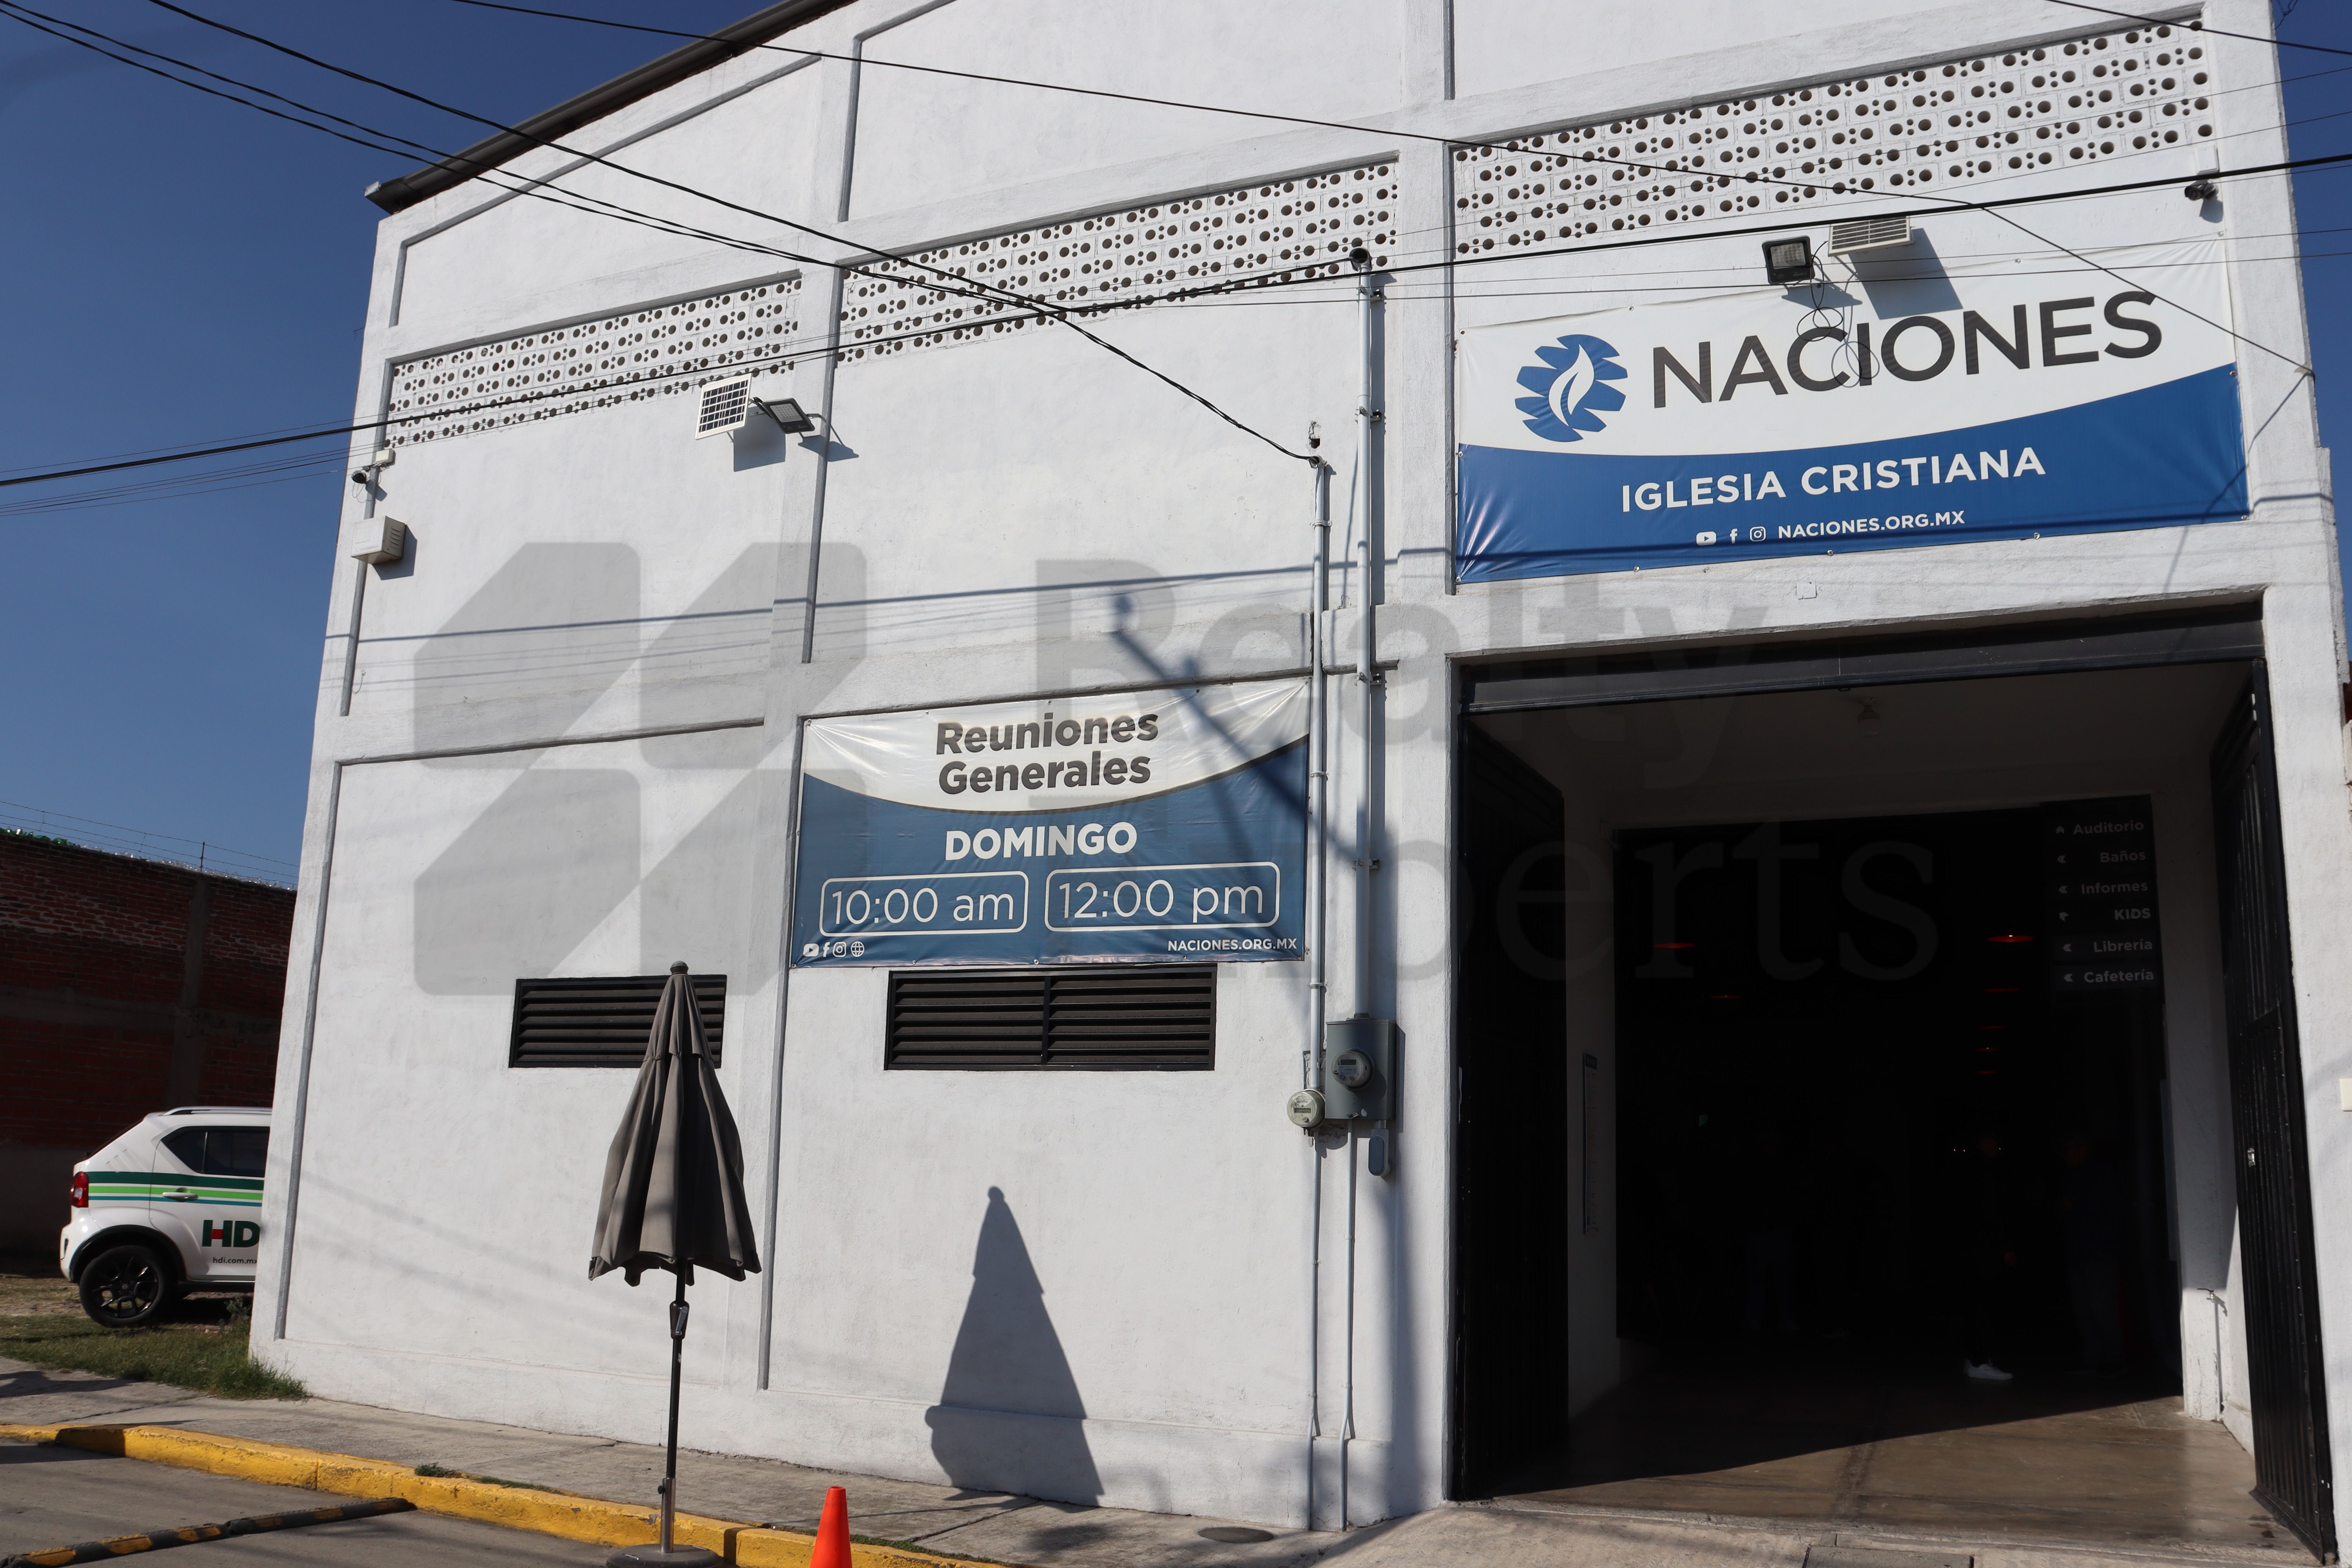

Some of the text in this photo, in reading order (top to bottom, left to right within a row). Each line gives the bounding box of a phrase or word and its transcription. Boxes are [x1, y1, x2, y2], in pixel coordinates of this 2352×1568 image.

[1653, 291, 2162, 409] NACIONES
[1622, 446, 2046, 512] IGLESIA CRISTIANA
[1777, 510, 1965, 539] NACIONES.ORG.MX
[936, 711, 1159, 755] Reuniones
[939, 750, 1151, 795] Generales
[945, 821, 1138, 861] DOMINGO
[2073, 820, 2145, 835] Auditorio
[2100, 850, 2146, 863] Baños
[1058, 878, 1263, 923] 12:00 pm
[2081, 882, 2148, 895] Informes
[831, 887, 1015, 925] 10:00 am
[2114, 908, 2151, 920] KIDS
[1168, 938, 1297, 951] NACIONES.ORG.MX
[2094, 939, 2153, 953] Librería
[2083, 969, 2154, 983] Cafetería
[202, 1220, 260, 1247] HD
